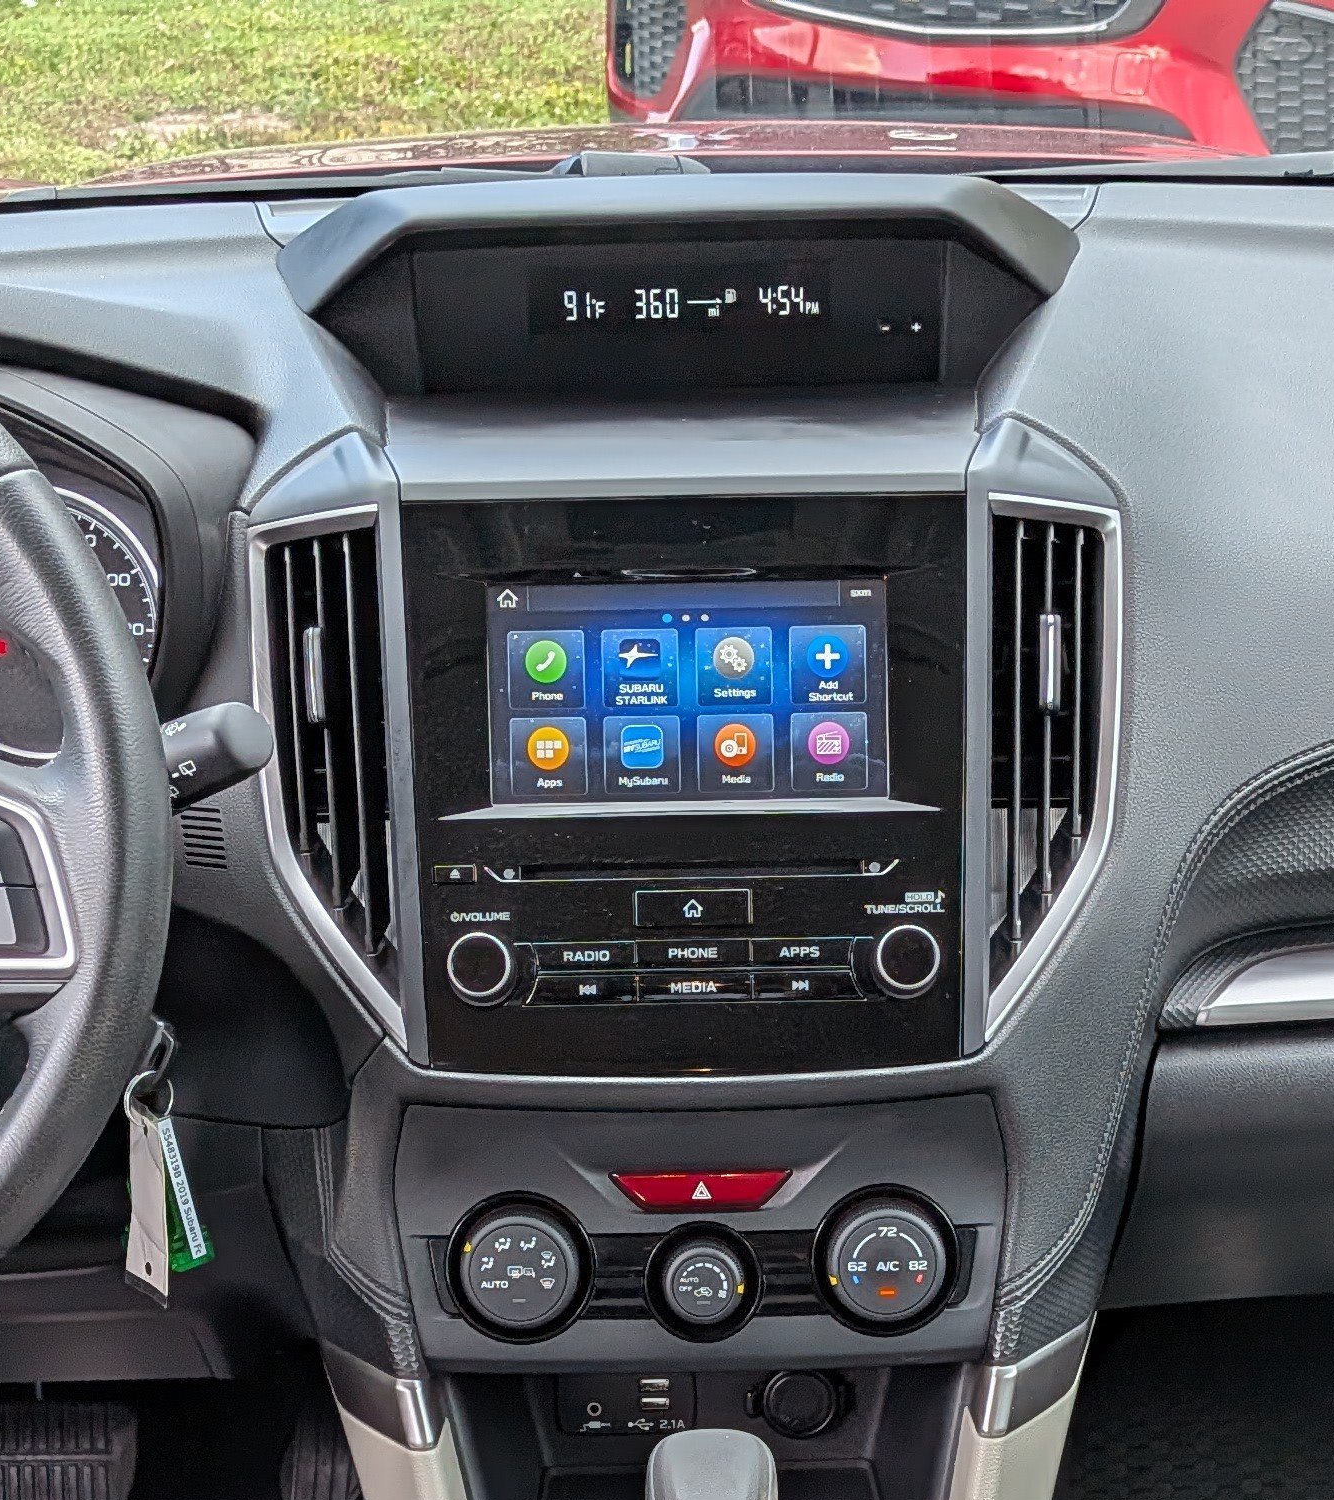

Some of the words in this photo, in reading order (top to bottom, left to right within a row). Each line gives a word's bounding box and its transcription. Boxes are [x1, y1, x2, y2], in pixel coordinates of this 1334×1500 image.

[635, 288, 679, 320] 360
[708, 306, 720, 317] mi
[619, 683, 664, 694] SUBARU
[819, 681, 839, 690] Add
[532, 691, 564, 702] Phone
[714, 687, 757, 699] Settings
[809, 691, 854, 702] Shortcut
[615, 695, 668, 705] STARLINK
[537, 777, 563, 789] Apps
[618, 775, 669, 787] MySubaru
[722, 774, 751, 784] Media
[816, 772, 845, 783] Radio
[906, 892, 933, 901] HOLD
[864, 904, 946, 914] TUNE/SCROLL
[563, 950, 610, 962] RADIO
[668, 947, 718, 960] PHONE
[779, 945, 820, 959] APPS
[670, 981, 717, 994] MEDIA
[176, 1180, 190, 1205] 2019
[184, 1207, 199, 1241] Subaru
[878, 1226, 897, 1237] 72
[847, 1261, 867, 1272] 62
[876, 1261, 900, 1272] A/C
[908, 1260, 928, 1271] 82
[481, 1280, 509, 1289] AUTO
[659, 1419, 685, 1430] 2.1A
